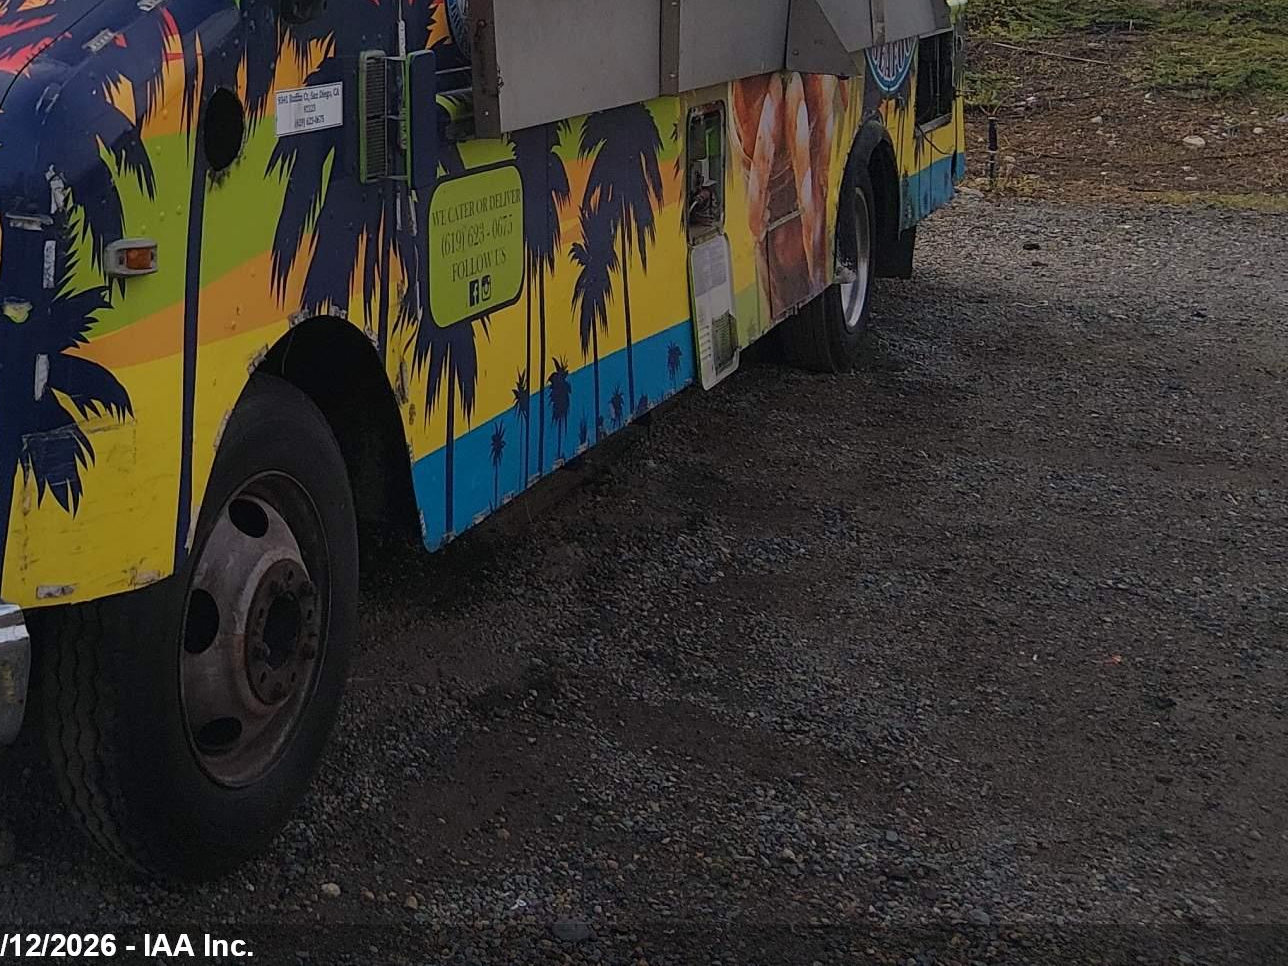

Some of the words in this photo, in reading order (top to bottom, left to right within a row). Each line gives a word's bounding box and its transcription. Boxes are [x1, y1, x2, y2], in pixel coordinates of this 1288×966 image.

[432, 210, 446, 227] WE
[446, 202, 474, 223] CATER
[476, 199, 488, 215] OR
[489, 188, 521, 211] DELIVER
[451, 251, 494, 283] FOLLOW
